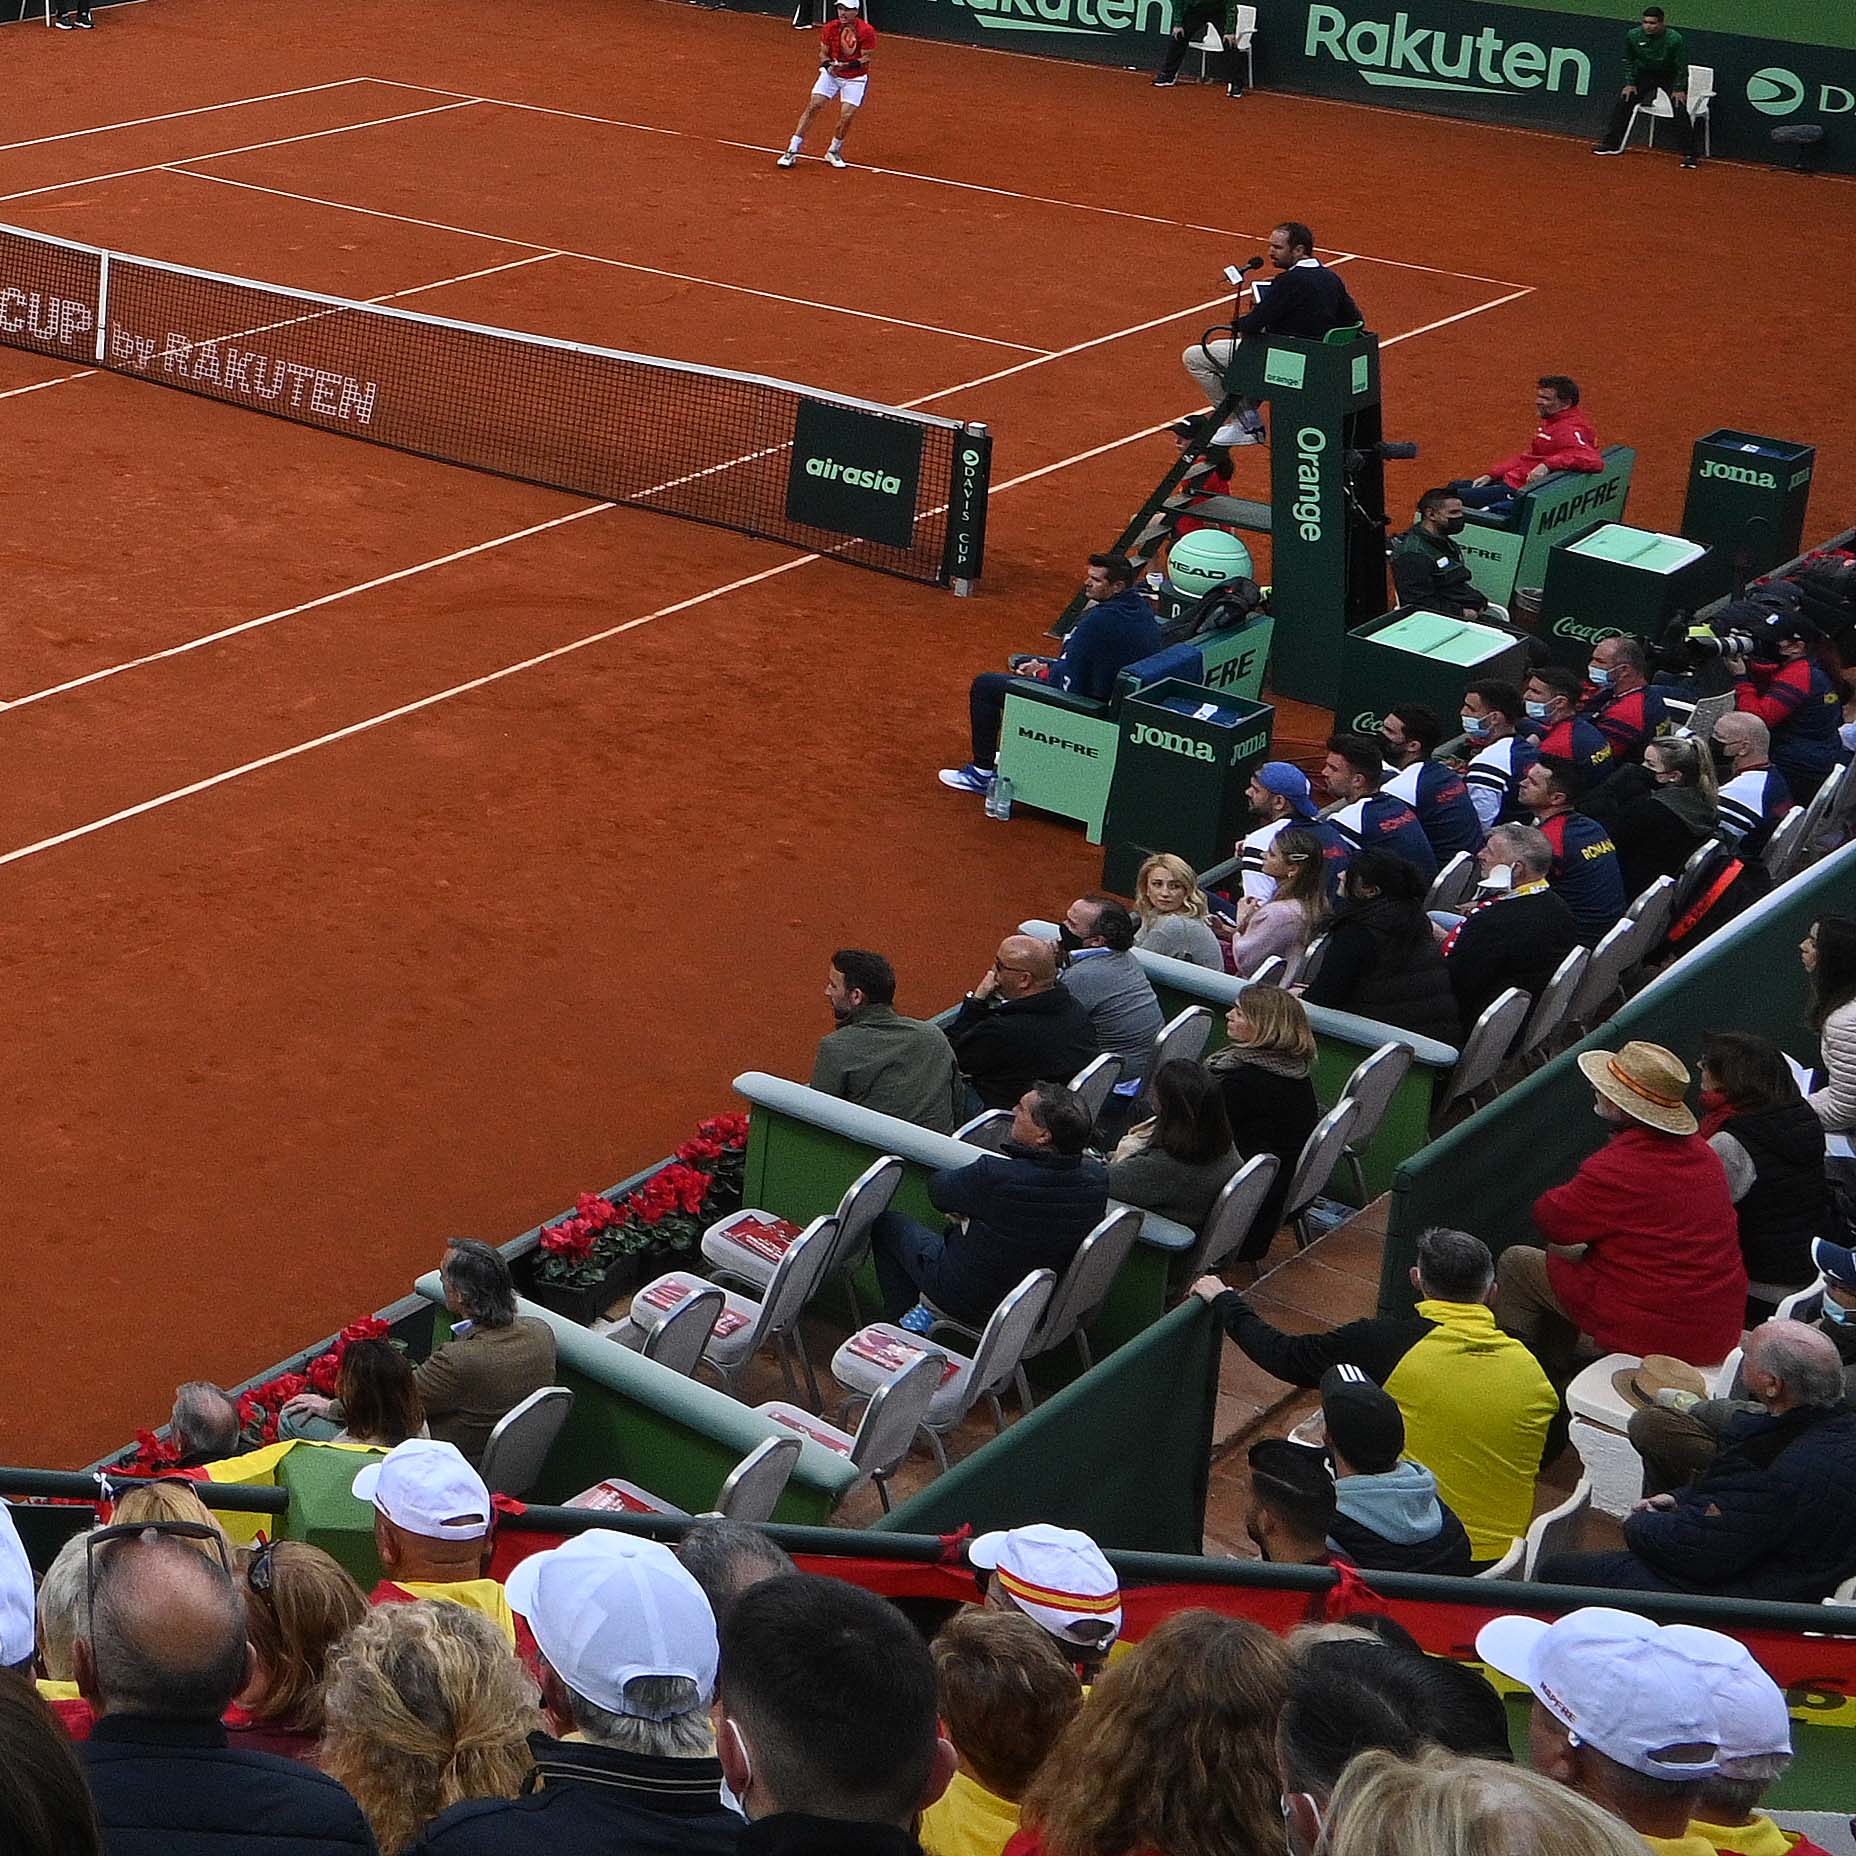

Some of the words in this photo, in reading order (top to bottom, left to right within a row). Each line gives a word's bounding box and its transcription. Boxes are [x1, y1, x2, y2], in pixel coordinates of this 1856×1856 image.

[1304, 3, 1592, 96] Rakuten
[111, 321, 154, 370] by
[164, 332, 376, 425] RAKUTEN
[805, 457, 902, 495] airasia
[961, 467, 975, 521] DAVIS
[1292, 426, 1326, 543] Orange
[1537, 476, 1621, 535] MAPFRE
[957, 533, 969, 564] CUP
[1169, 560, 1227, 580] HEAD
[1203, 649, 1257, 688] FRE
[1018, 727, 1100, 759] MAPFRE
